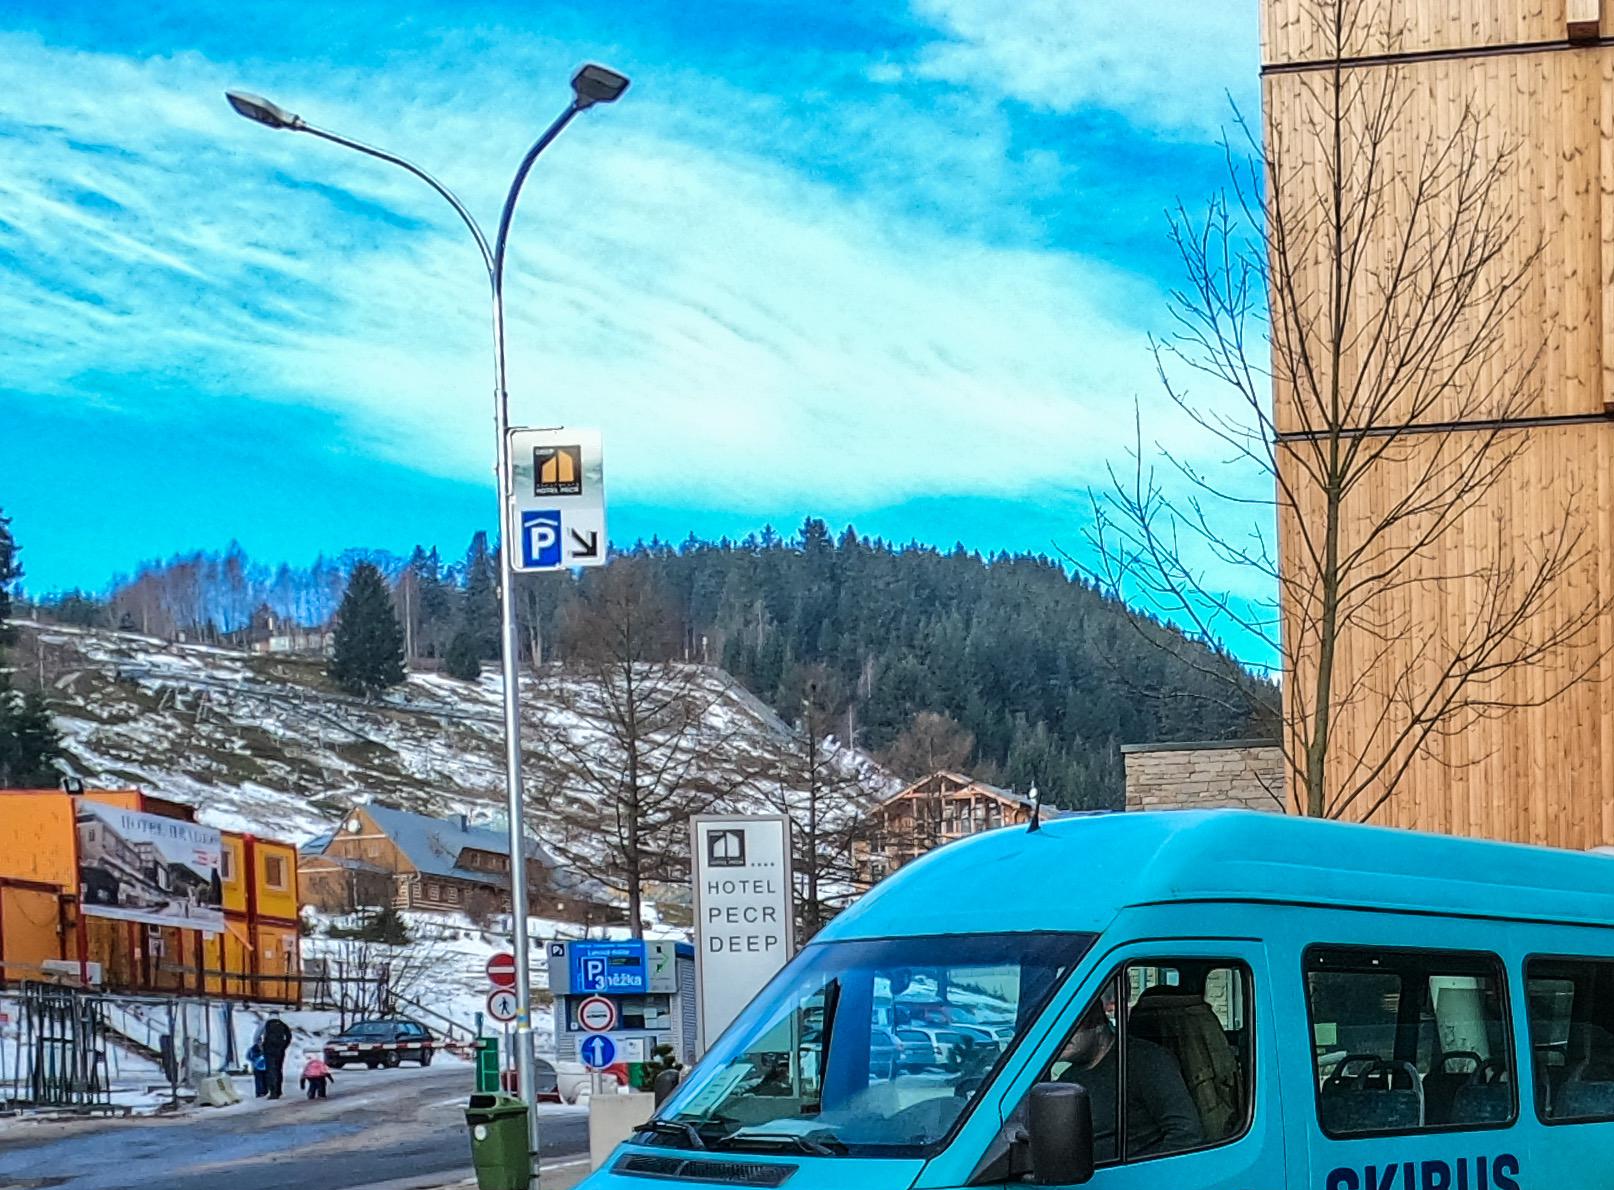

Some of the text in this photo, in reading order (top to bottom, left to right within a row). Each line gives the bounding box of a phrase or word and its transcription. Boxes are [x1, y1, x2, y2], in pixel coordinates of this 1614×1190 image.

[531, 527, 556, 561] P
[708, 880, 776, 894] HOTEL
[709, 906, 777, 924] PECR
[709, 935, 778, 953] DEEP
